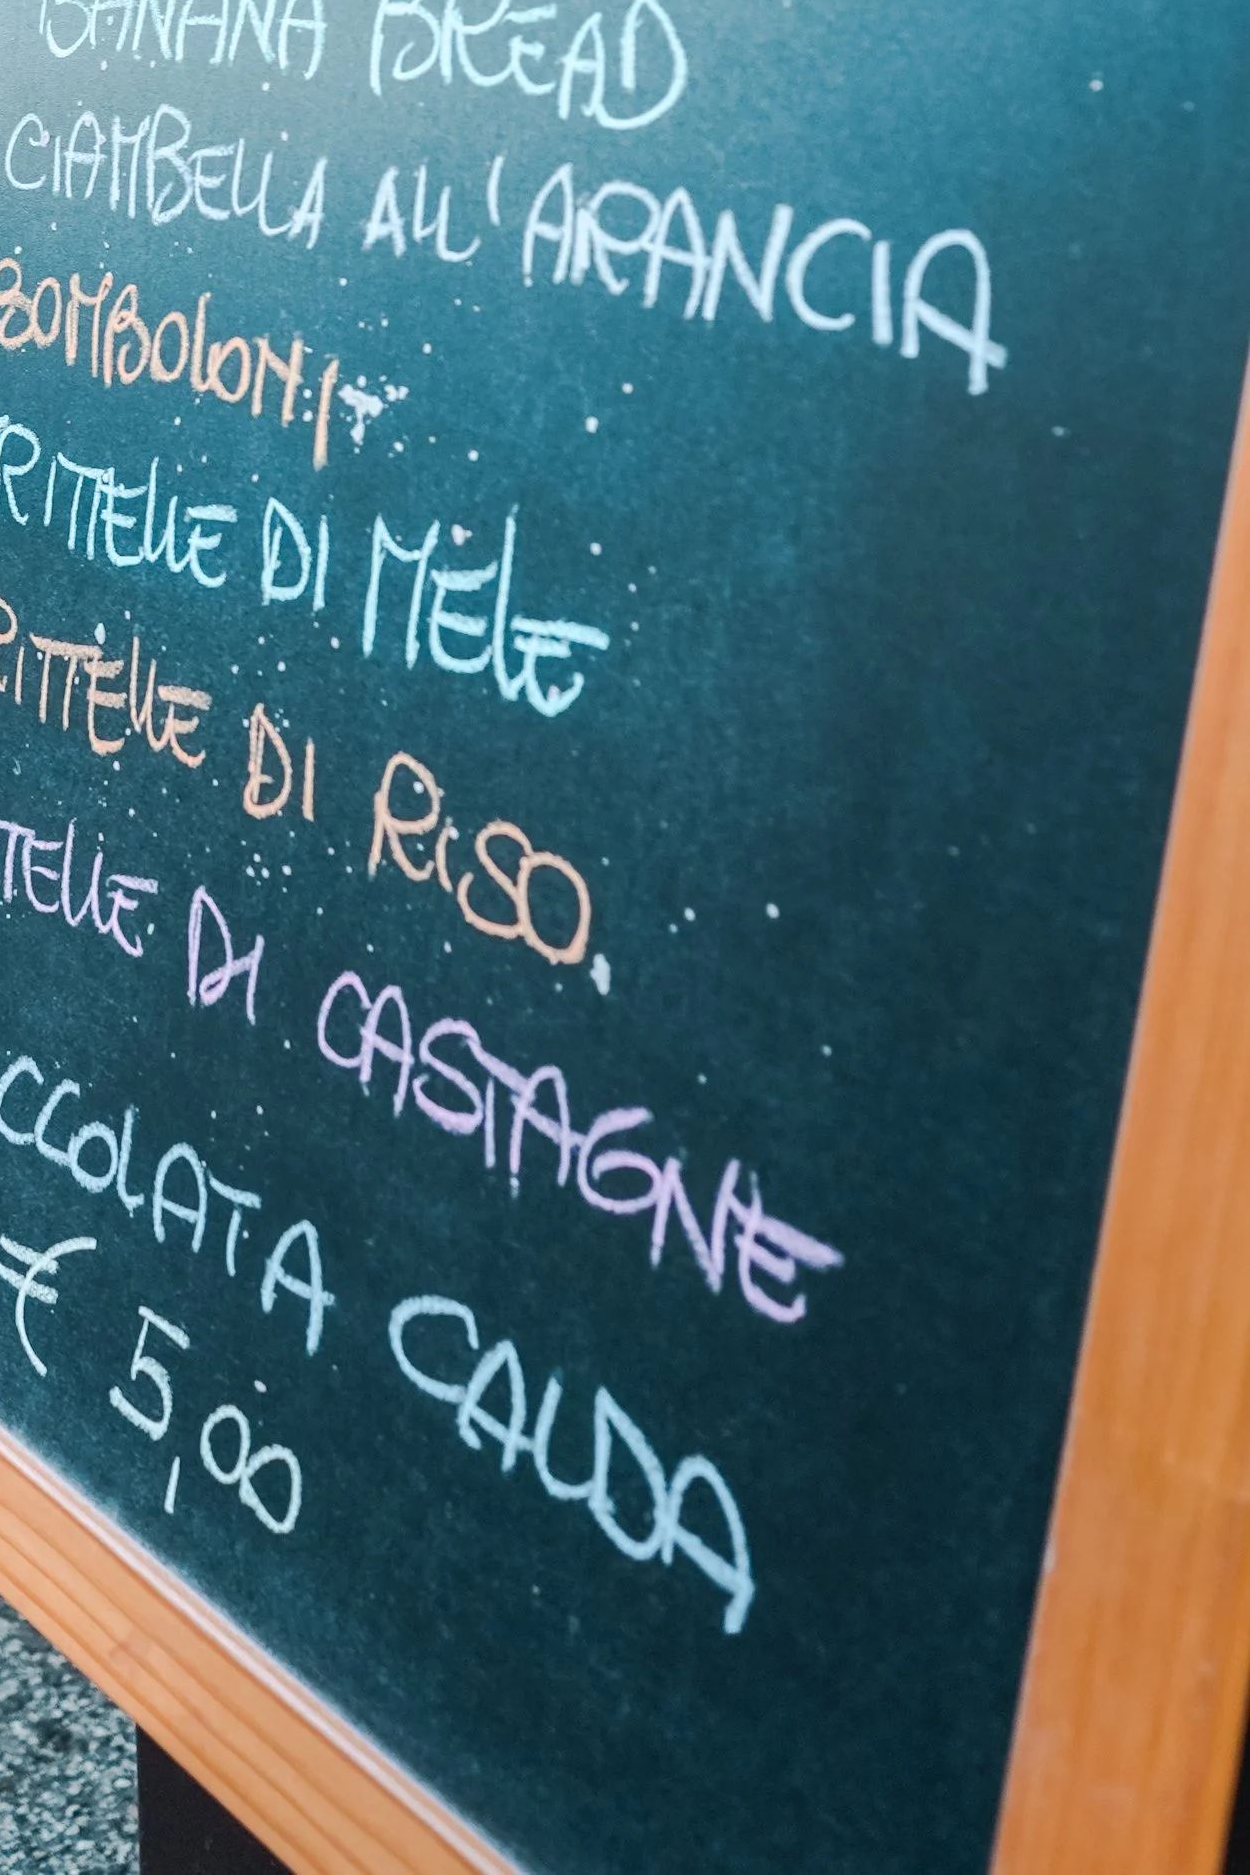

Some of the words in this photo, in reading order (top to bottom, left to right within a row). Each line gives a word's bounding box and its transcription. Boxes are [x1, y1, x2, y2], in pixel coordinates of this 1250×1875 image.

[4, 105, 326, 249] CIAMBELLA
[262, 499, 330, 610] DI
[362, 507, 609, 715] MELE
[244, 705, 315, 821] DI
[188, 887, 262, 1024] DI
[317, 972, 843, 1321] CASTAGNE
[111, 1307, 301, 1533] 5,00
[390, 1297, 754, 1633] CALDA
